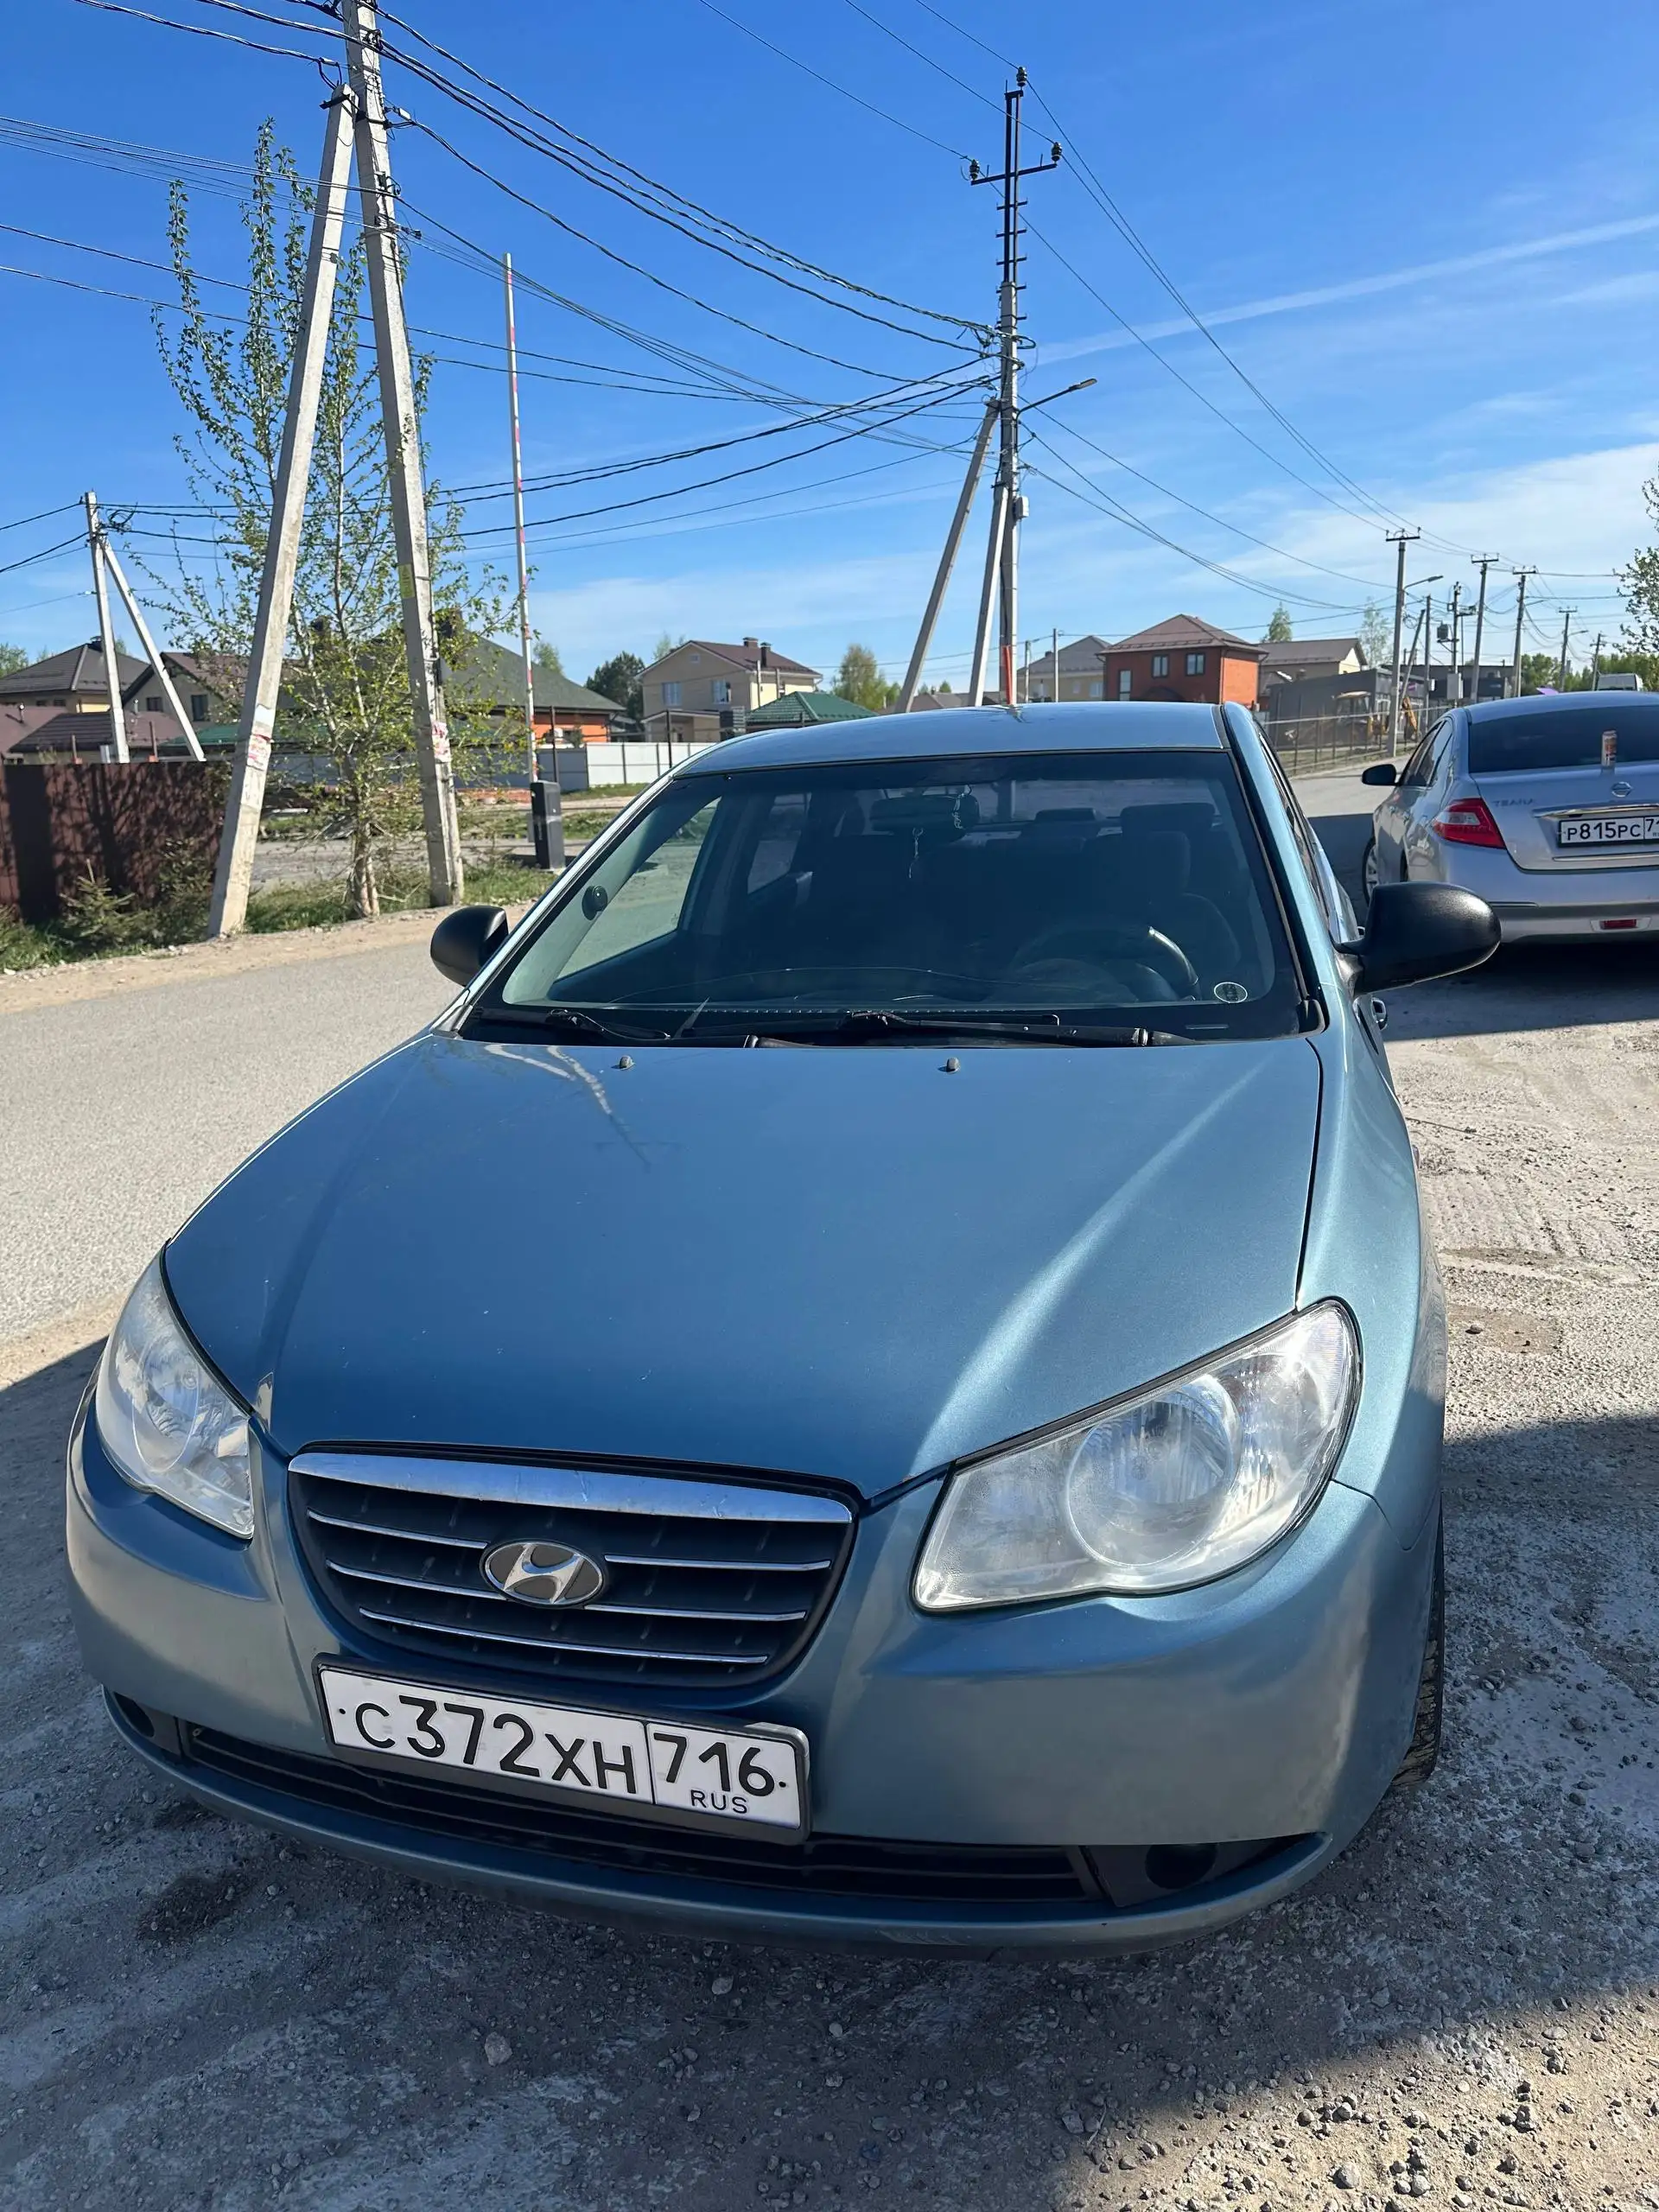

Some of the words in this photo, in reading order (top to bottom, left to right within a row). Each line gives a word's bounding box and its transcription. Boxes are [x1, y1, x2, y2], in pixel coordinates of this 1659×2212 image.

[1645, 818, 1659, 832] 7
[653, 1732, 775, 1797] 716
[690, 1789, 748, 1814] RUS
